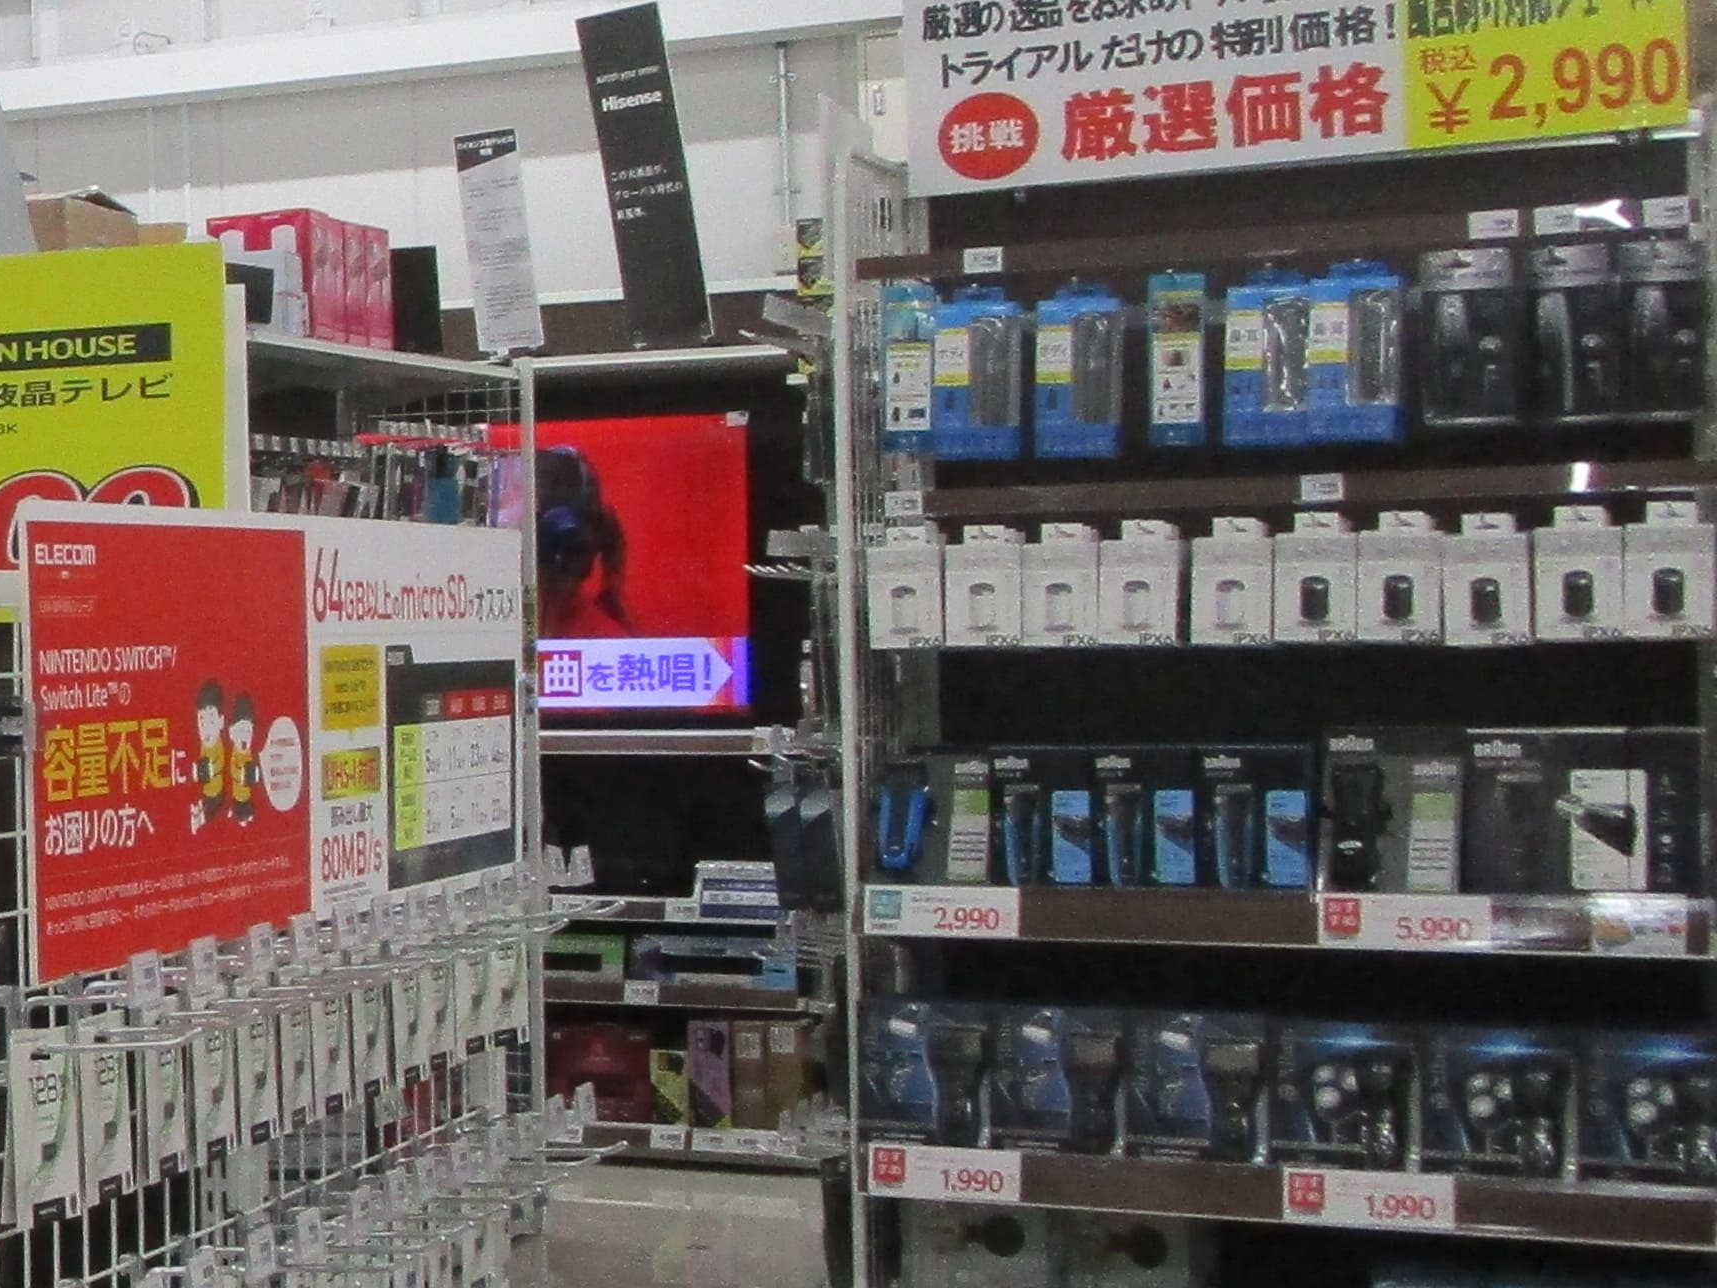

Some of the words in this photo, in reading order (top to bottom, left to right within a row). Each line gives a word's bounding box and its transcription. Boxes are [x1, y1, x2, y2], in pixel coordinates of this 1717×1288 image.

[1420, 46, 1476, 75] 税込
[602, 90, 662, 112] Hisense
[1063, 62, 1391, 161] 厳選価格
[950, 117, 1024, 155] 挑戦
[24, 333, 137, 362] HOUSE
[35, 544, 96, 565] ELECOM
[39, 648, 111, 674] NINTENDO
[40, 684, 82, 711] Switch
[42, 717, 187, 803] 容量不足に
[44, 807, 155, 858] お困りの方へ
[932, 907, 1001, 932] 2,990
[1395, 916, 1473, 942] 5,990
[940, 1168, 1004, 1194] 1,990
[1365, 1195, 1436, 1221] 1,990
